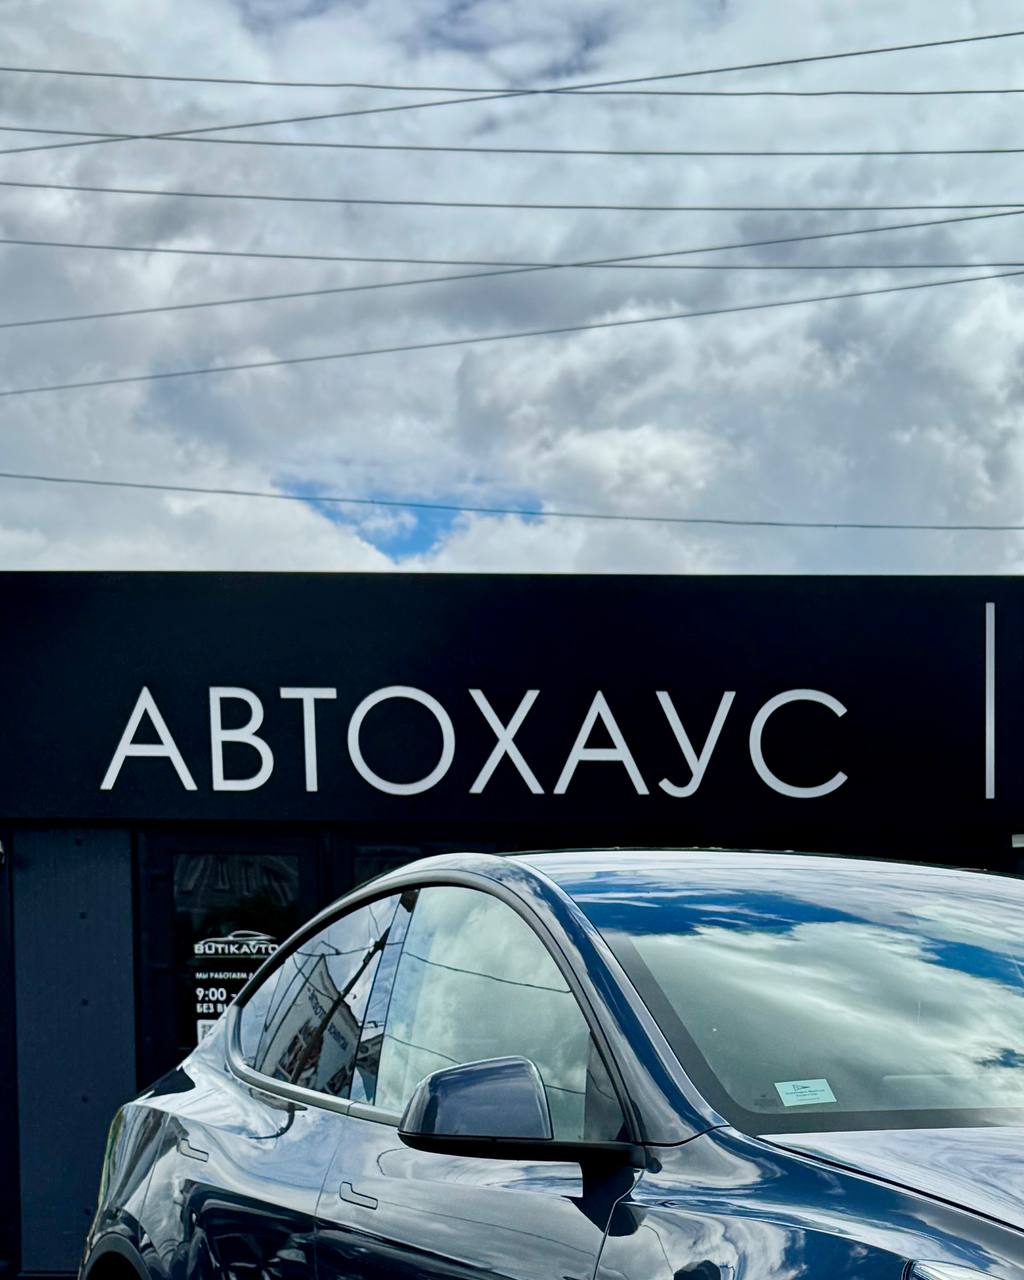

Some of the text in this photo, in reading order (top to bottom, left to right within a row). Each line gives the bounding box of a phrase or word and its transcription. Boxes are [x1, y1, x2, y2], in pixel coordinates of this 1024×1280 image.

[100, 686, 848, 799] АВТОХАУС
[195, 988, 227, 1002] 9:00
[196, 1003, 215, 1014] БЕЗ
